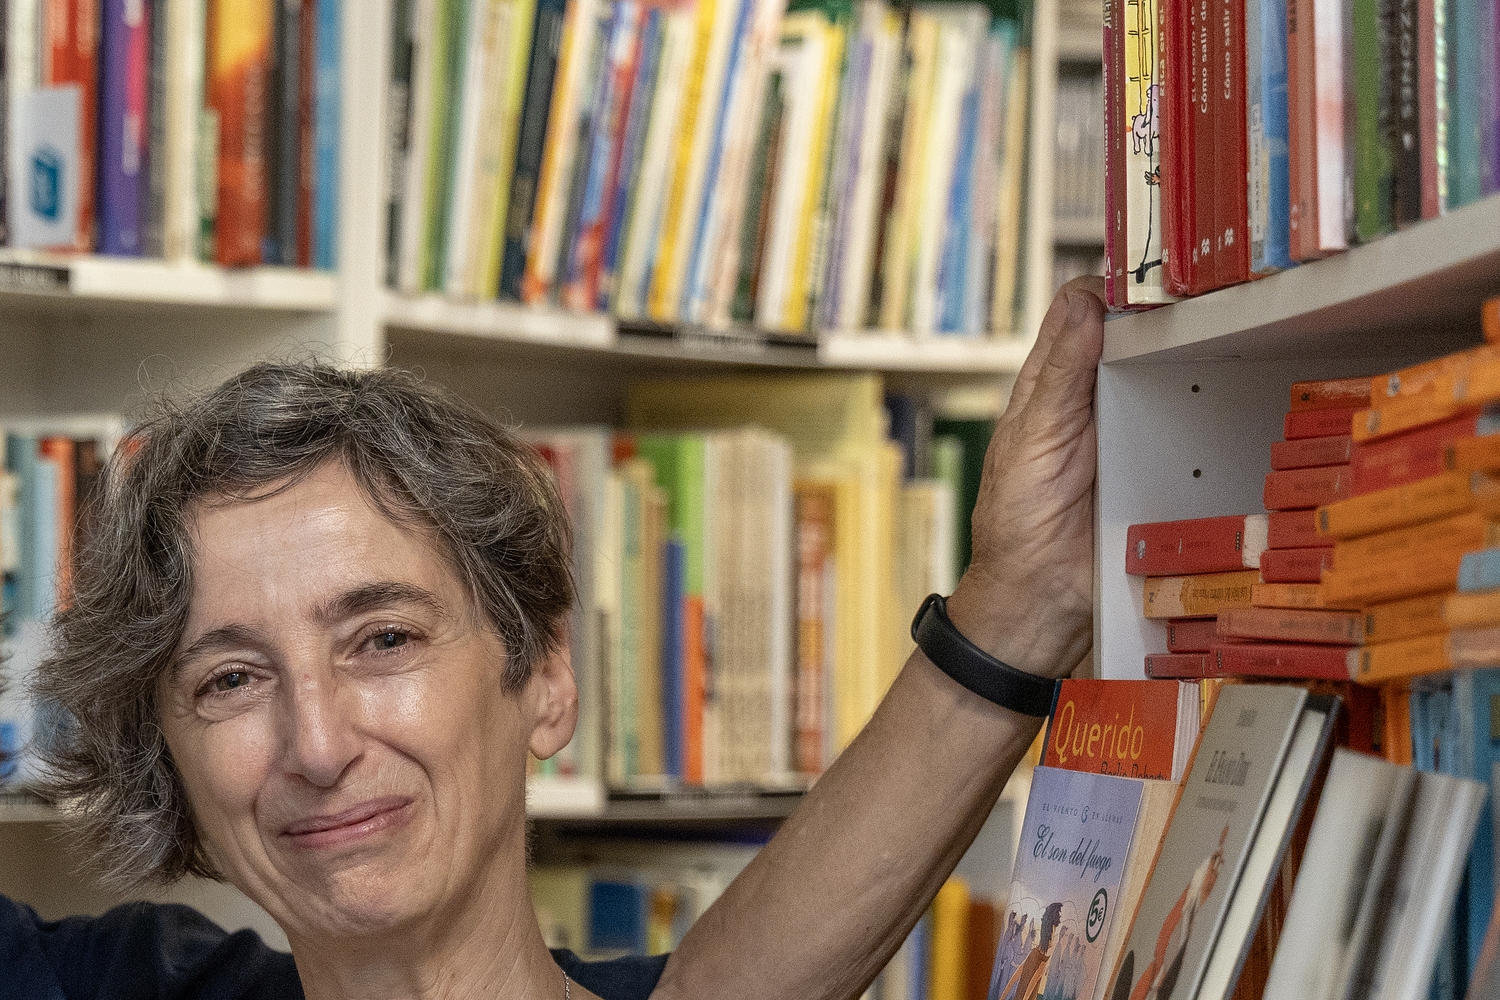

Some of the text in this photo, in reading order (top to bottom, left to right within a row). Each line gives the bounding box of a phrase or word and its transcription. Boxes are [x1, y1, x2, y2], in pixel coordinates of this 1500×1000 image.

[1200, 25, 1208, 63] salir
[1222, 8, 1232, 101] Cómo salir
[1200, 68, 1209, 114] Cómo
[1055, 700, 1145, 764] Querido
[1053, 804, 1079, 818] VIENTO
[1033, 823, 1113, 883] El son del fuego
